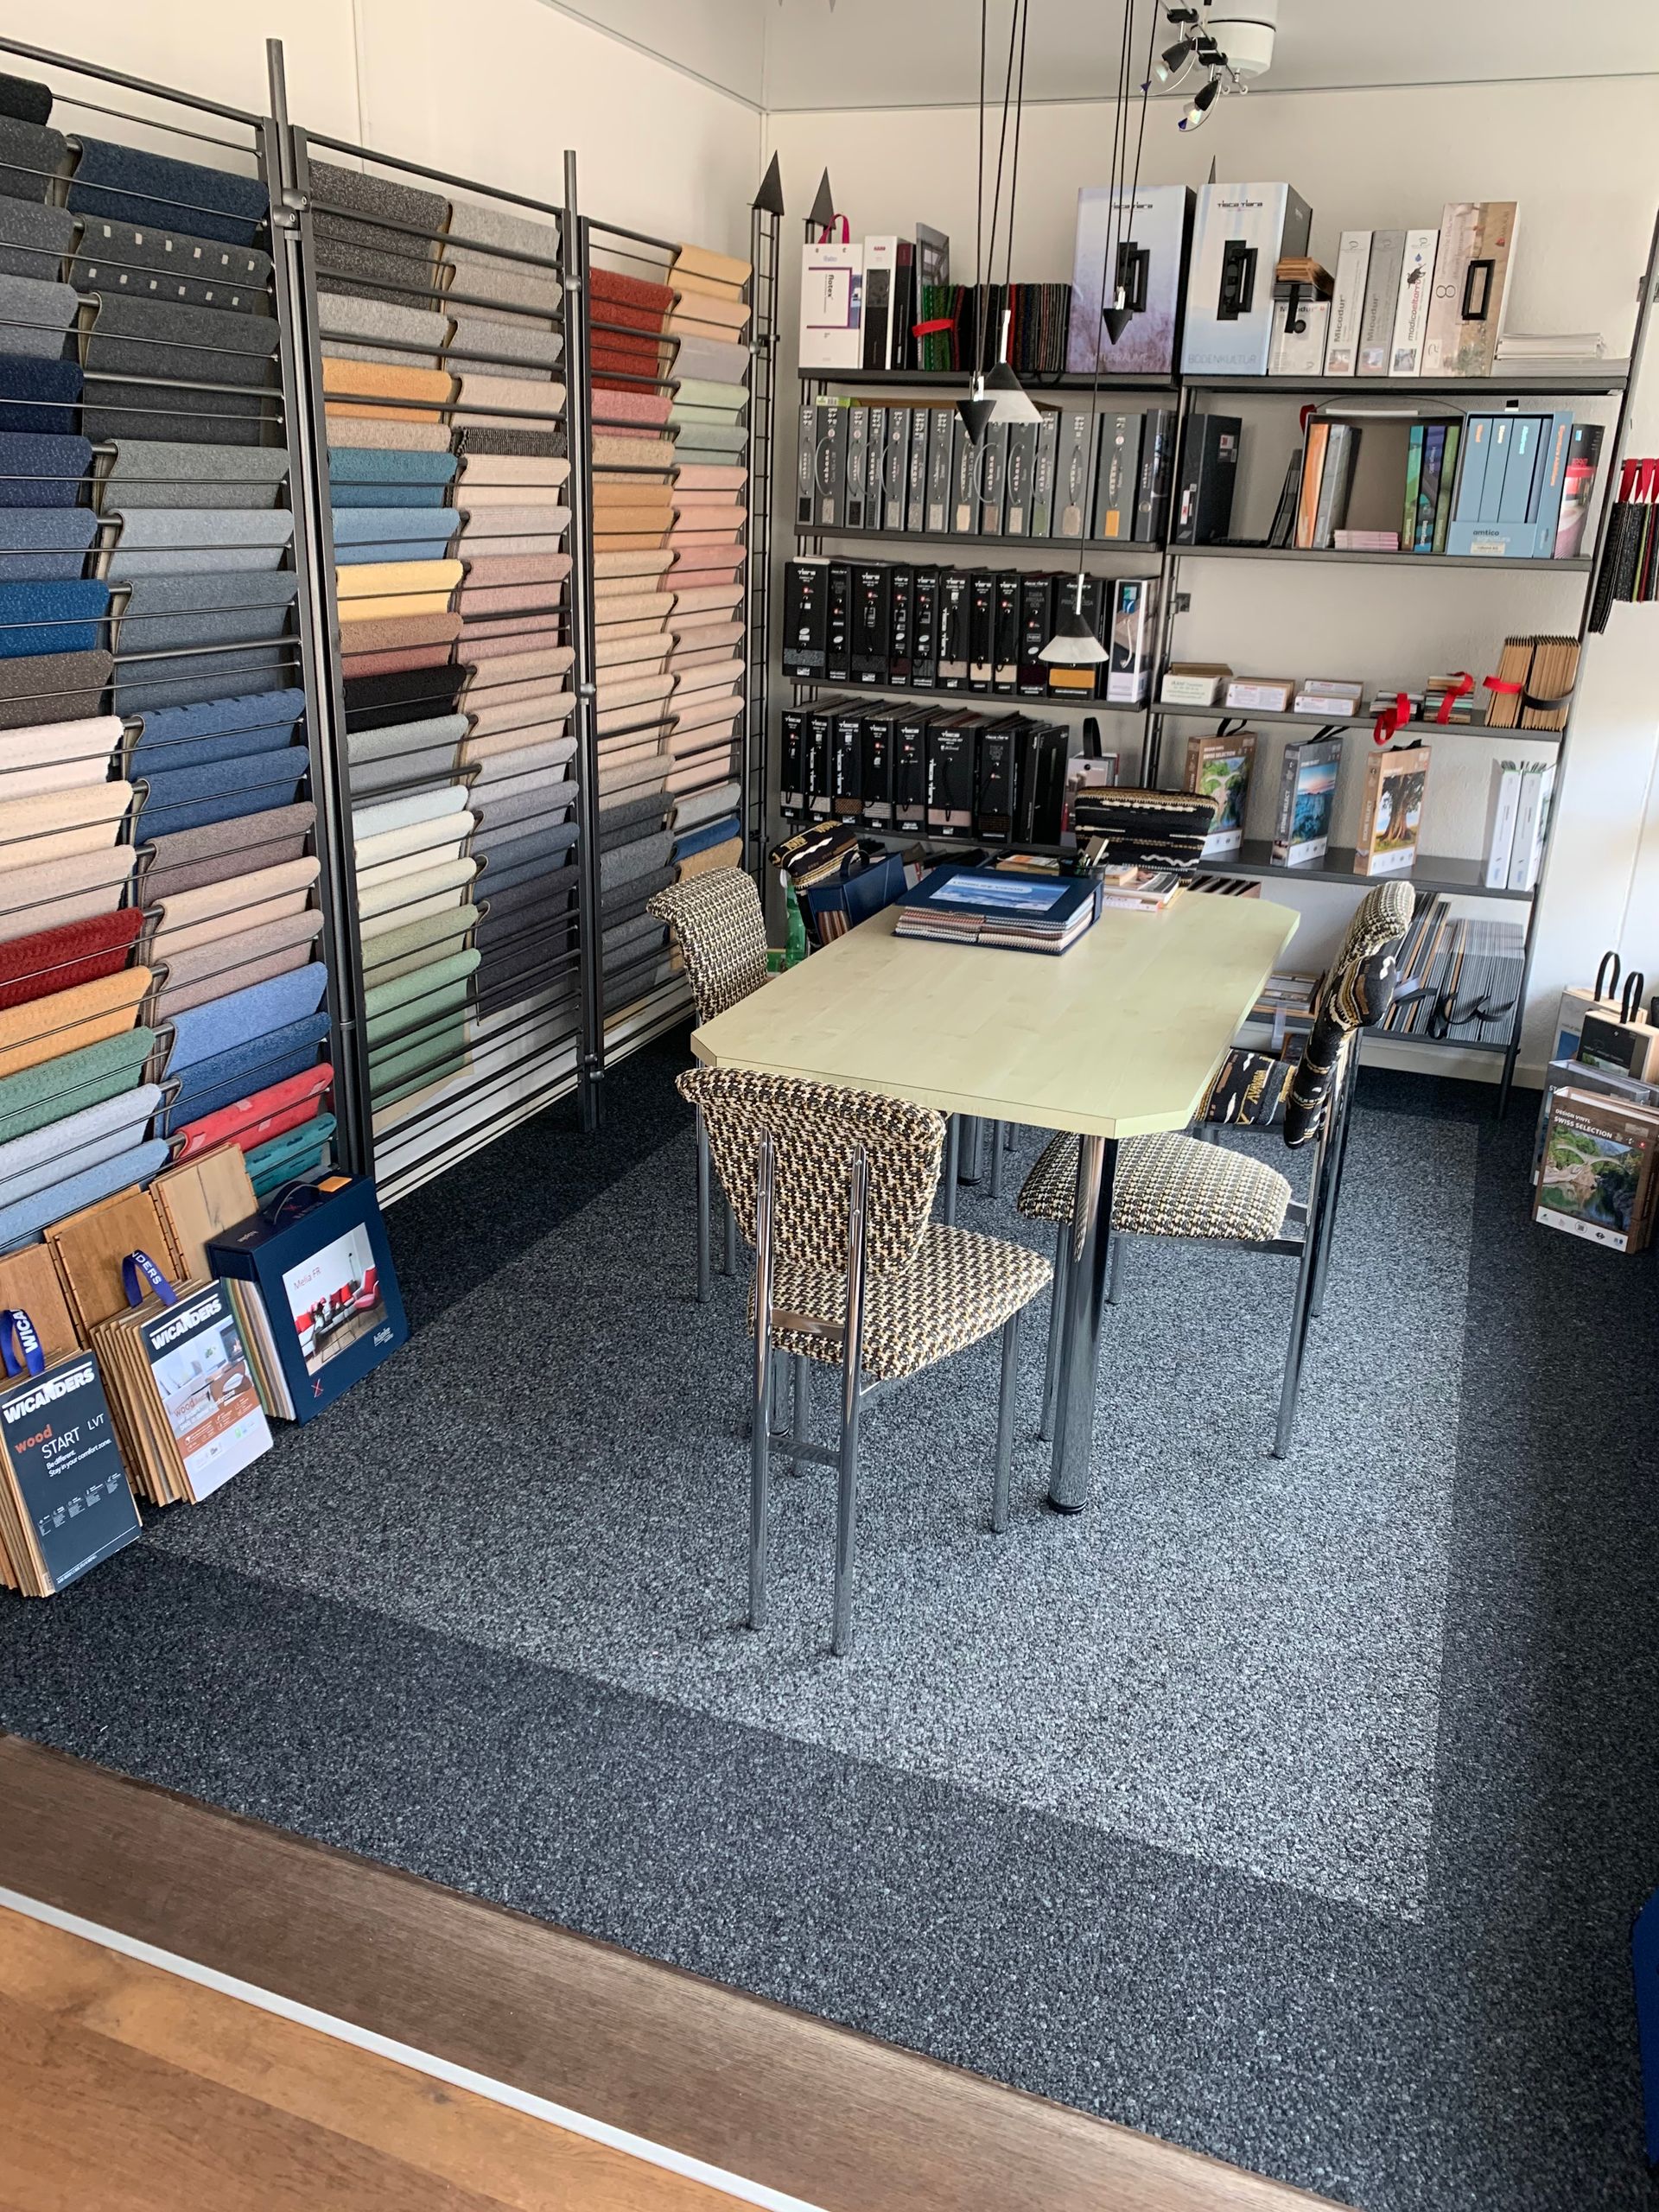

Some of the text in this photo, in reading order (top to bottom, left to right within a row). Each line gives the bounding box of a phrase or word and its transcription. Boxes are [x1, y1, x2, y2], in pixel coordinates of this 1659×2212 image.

[1435, 284, 1456, 299] 8
[1554, 1116, 1613, 1140] SWISS SELECTION
[1555, 1109, 1592, 1124] DESIGN VINYL
[312, 1266, 322, 1279] FR
[150, 1298, 222, 1351] WICANDERS
[3, 1367, 95, 1424] WICANDERS
[14, 1424, 54, 1454] wood
[41, 1413, 105, 1459] START LVT
[46, 1461, 55, 1471] Be
[48, 1467, 61, 1478] Stay
[65, 1456, 79, 1471] your
[78, 1446, 99, 1460] comfort
